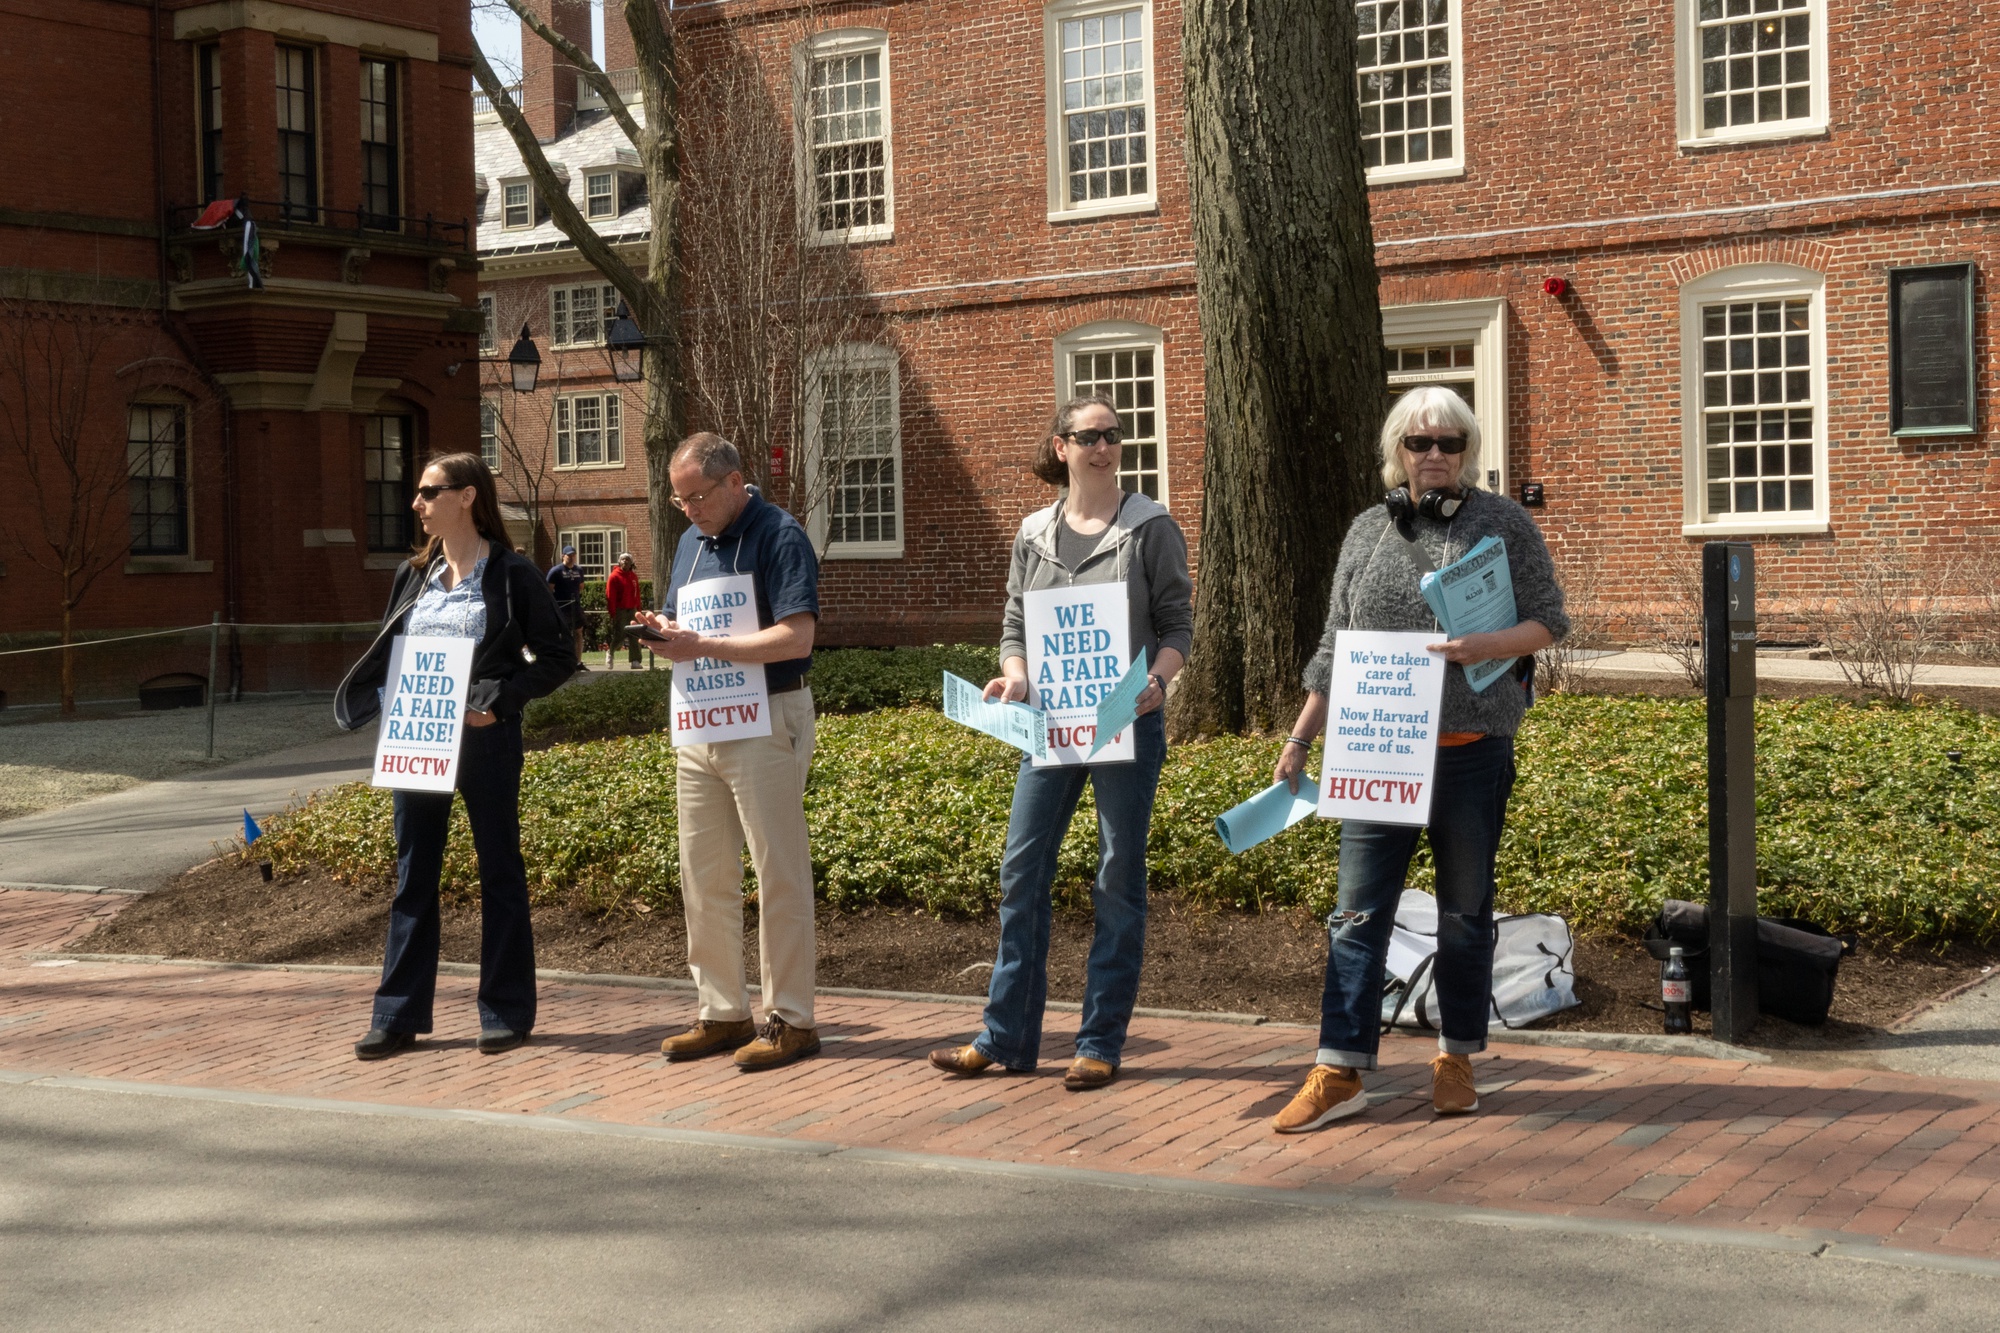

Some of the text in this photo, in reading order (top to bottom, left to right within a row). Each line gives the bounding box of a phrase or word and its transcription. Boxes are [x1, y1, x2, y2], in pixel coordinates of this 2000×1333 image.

[681, 591, 747, 616] HARVARD
[688, 613, 733, 631] STAFF
[1054, 603, 1095, 629] WE
[1042, 629, 1111, 657] NEED
[415, 651, 447, 672] WE
[1038, 655, 1121, 684] A FAIR
[1350, 651, 1430, 666] We've taken
[399, 674, 455, 696] NEED
[686, 671, 746, 693] RAISES
[1365, 668, 1412, 681] care of
[1039, 682, 1120, 711] RAISE
[1356, 682, 1416, 697] Harvard.
[389, 697, 457, 719] A FAIR
[677, 702, 759, 731] HUCTW
[1340, 707, 1429, 724] Now Harvard
[387, 720, 455, 743] RAISE!
[1338, 723, 1427, 740] needs to take
[1347, 740, 1414, 755] care of us.
[381, 755, 451, 776] HUCTW
[1328, 777, 1423, 804] HUCTW
